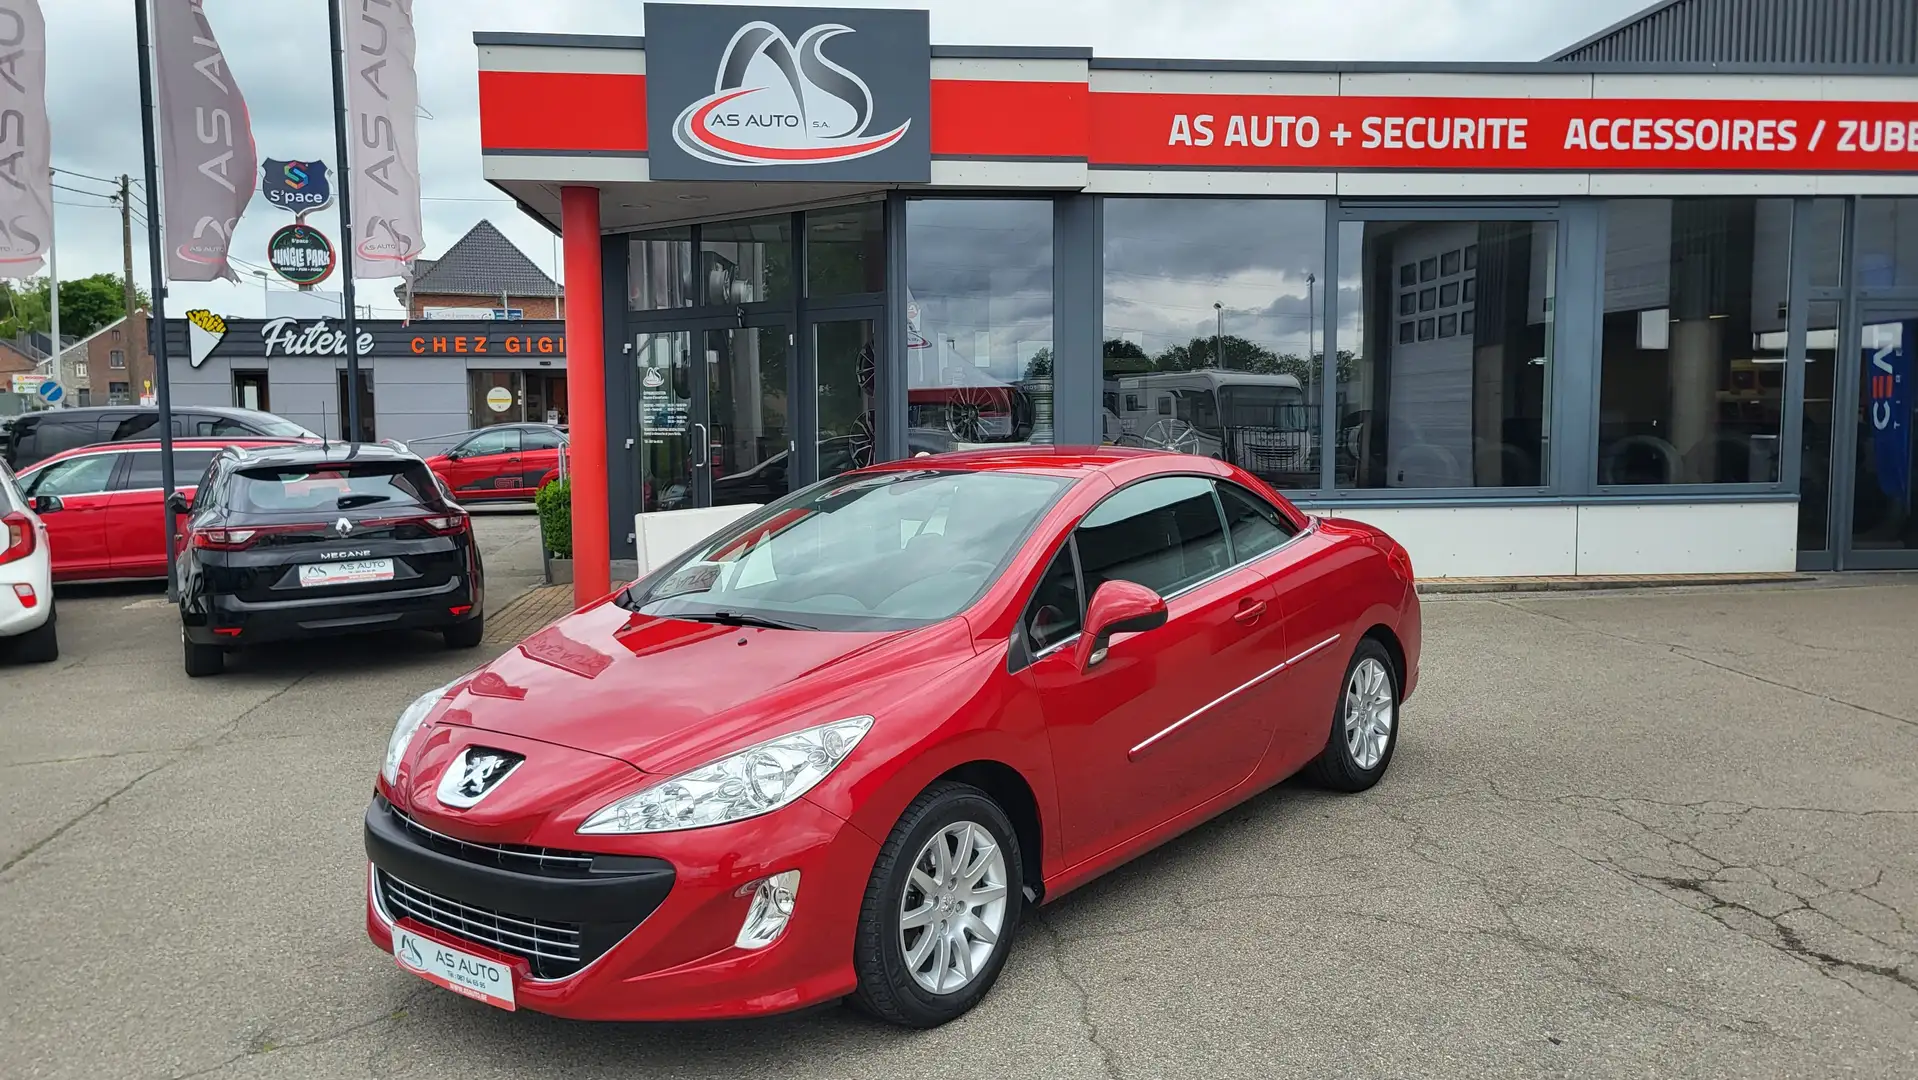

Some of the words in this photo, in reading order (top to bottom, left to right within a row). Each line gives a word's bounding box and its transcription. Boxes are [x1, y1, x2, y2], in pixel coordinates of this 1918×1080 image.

[711, 114, 740, 127] AS
[745, 114, 799, 128] AUTO
[1168, 114, 1214, 147] AS
[1224, 115, 1320, 148] AUTO
[1330, 123, 1351, 147] +
[1361, 116, 1528, 150] SECURITE
[1563, 118, 1797, 151] ACCESSOIRES
[1807, 119, 1826, 152] /
[196, 107, 236, 193] AS
[361, 113, 399, 195] AS
[270, 189, 323, 204] S'pace
[272, 247, 304, 267] JUNGLE
[306, 248, 331, 267] PARK
[411, 337, 487, 354] CHEZ
[505, 337, 564, 353] GIGI
[320, 549, 371, 559] MEGANE
[339, 563, 355, 571] AS
[357, 560, 386, 569] AUTO
[435, 950, 455, 968] AS
[459, 958, 499, 982] AUTO
